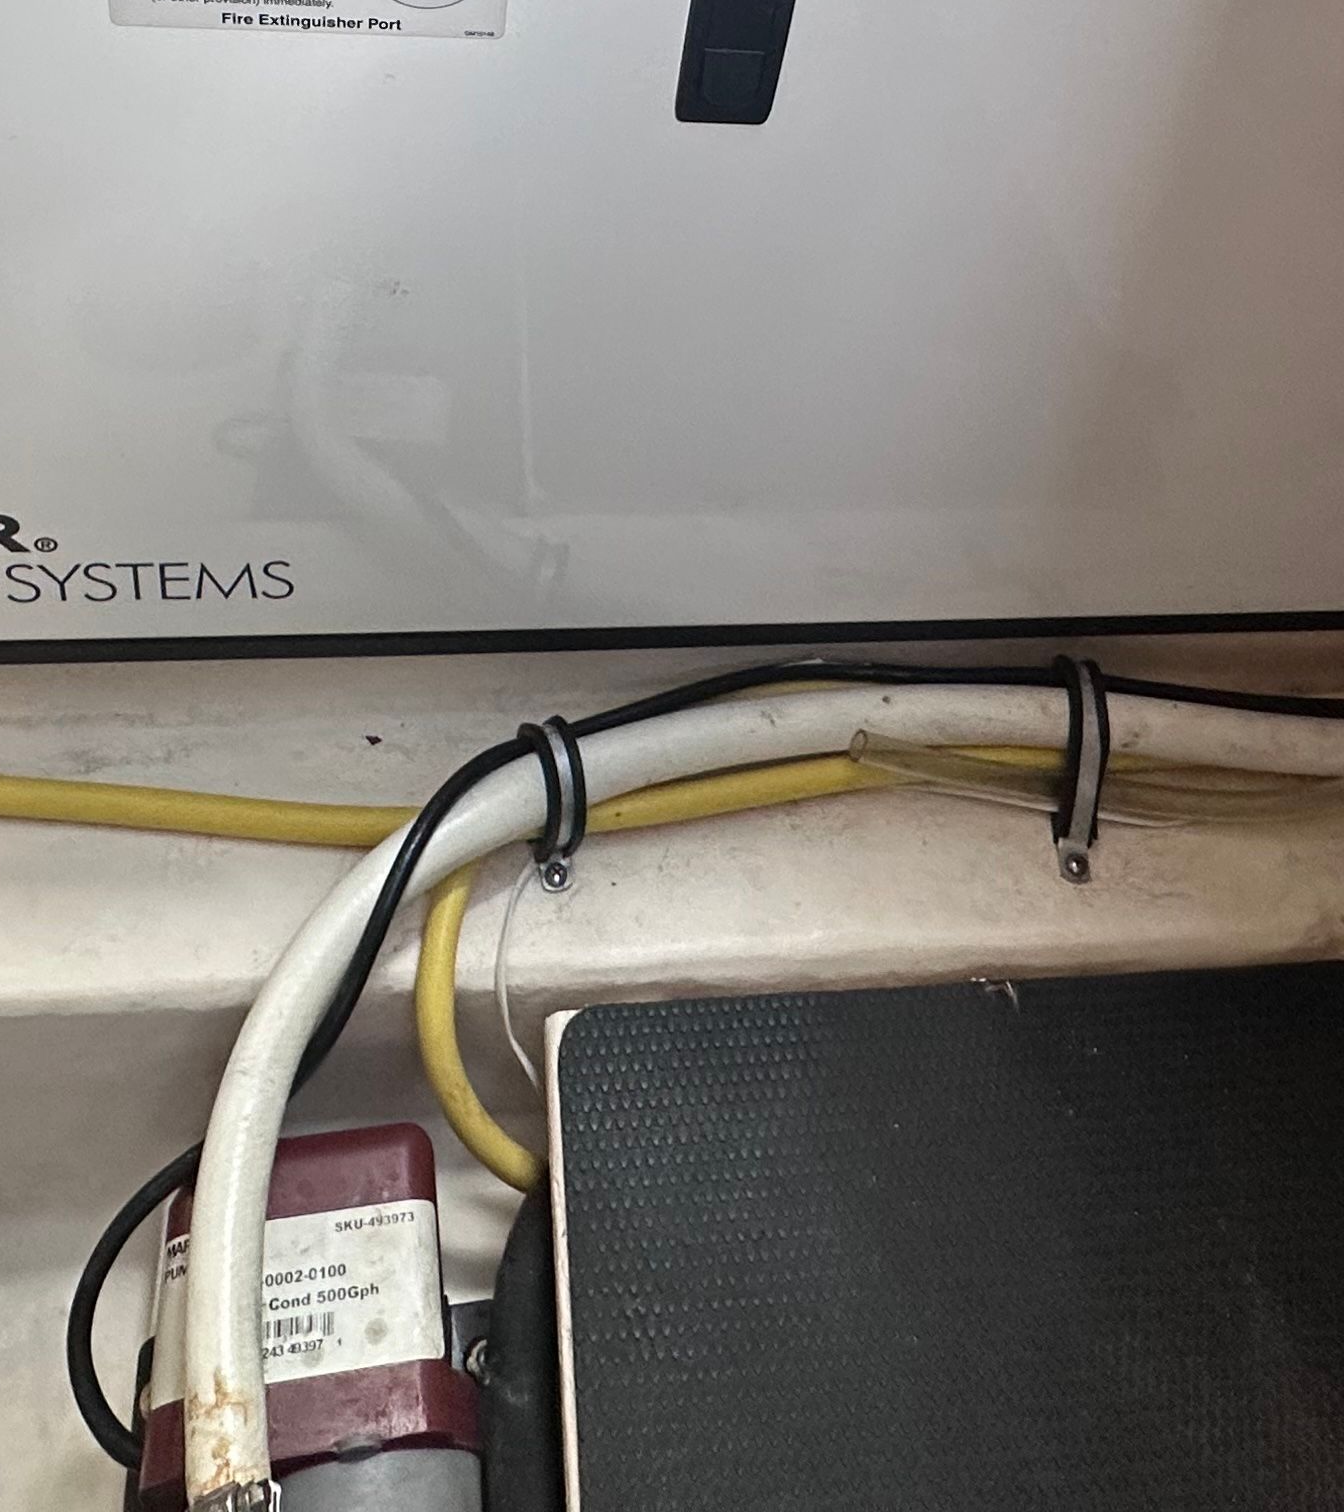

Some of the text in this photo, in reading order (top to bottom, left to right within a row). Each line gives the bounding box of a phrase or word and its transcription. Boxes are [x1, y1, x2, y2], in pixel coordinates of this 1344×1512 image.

[221, 12, 402, 31] Fire Extinguisher Port
[5, 560, 295, 604] SYSTEMS
[335, 1211, 415, 1232] SKU-493973
[268, 1283, 379, 1311] Cond 500Gph
